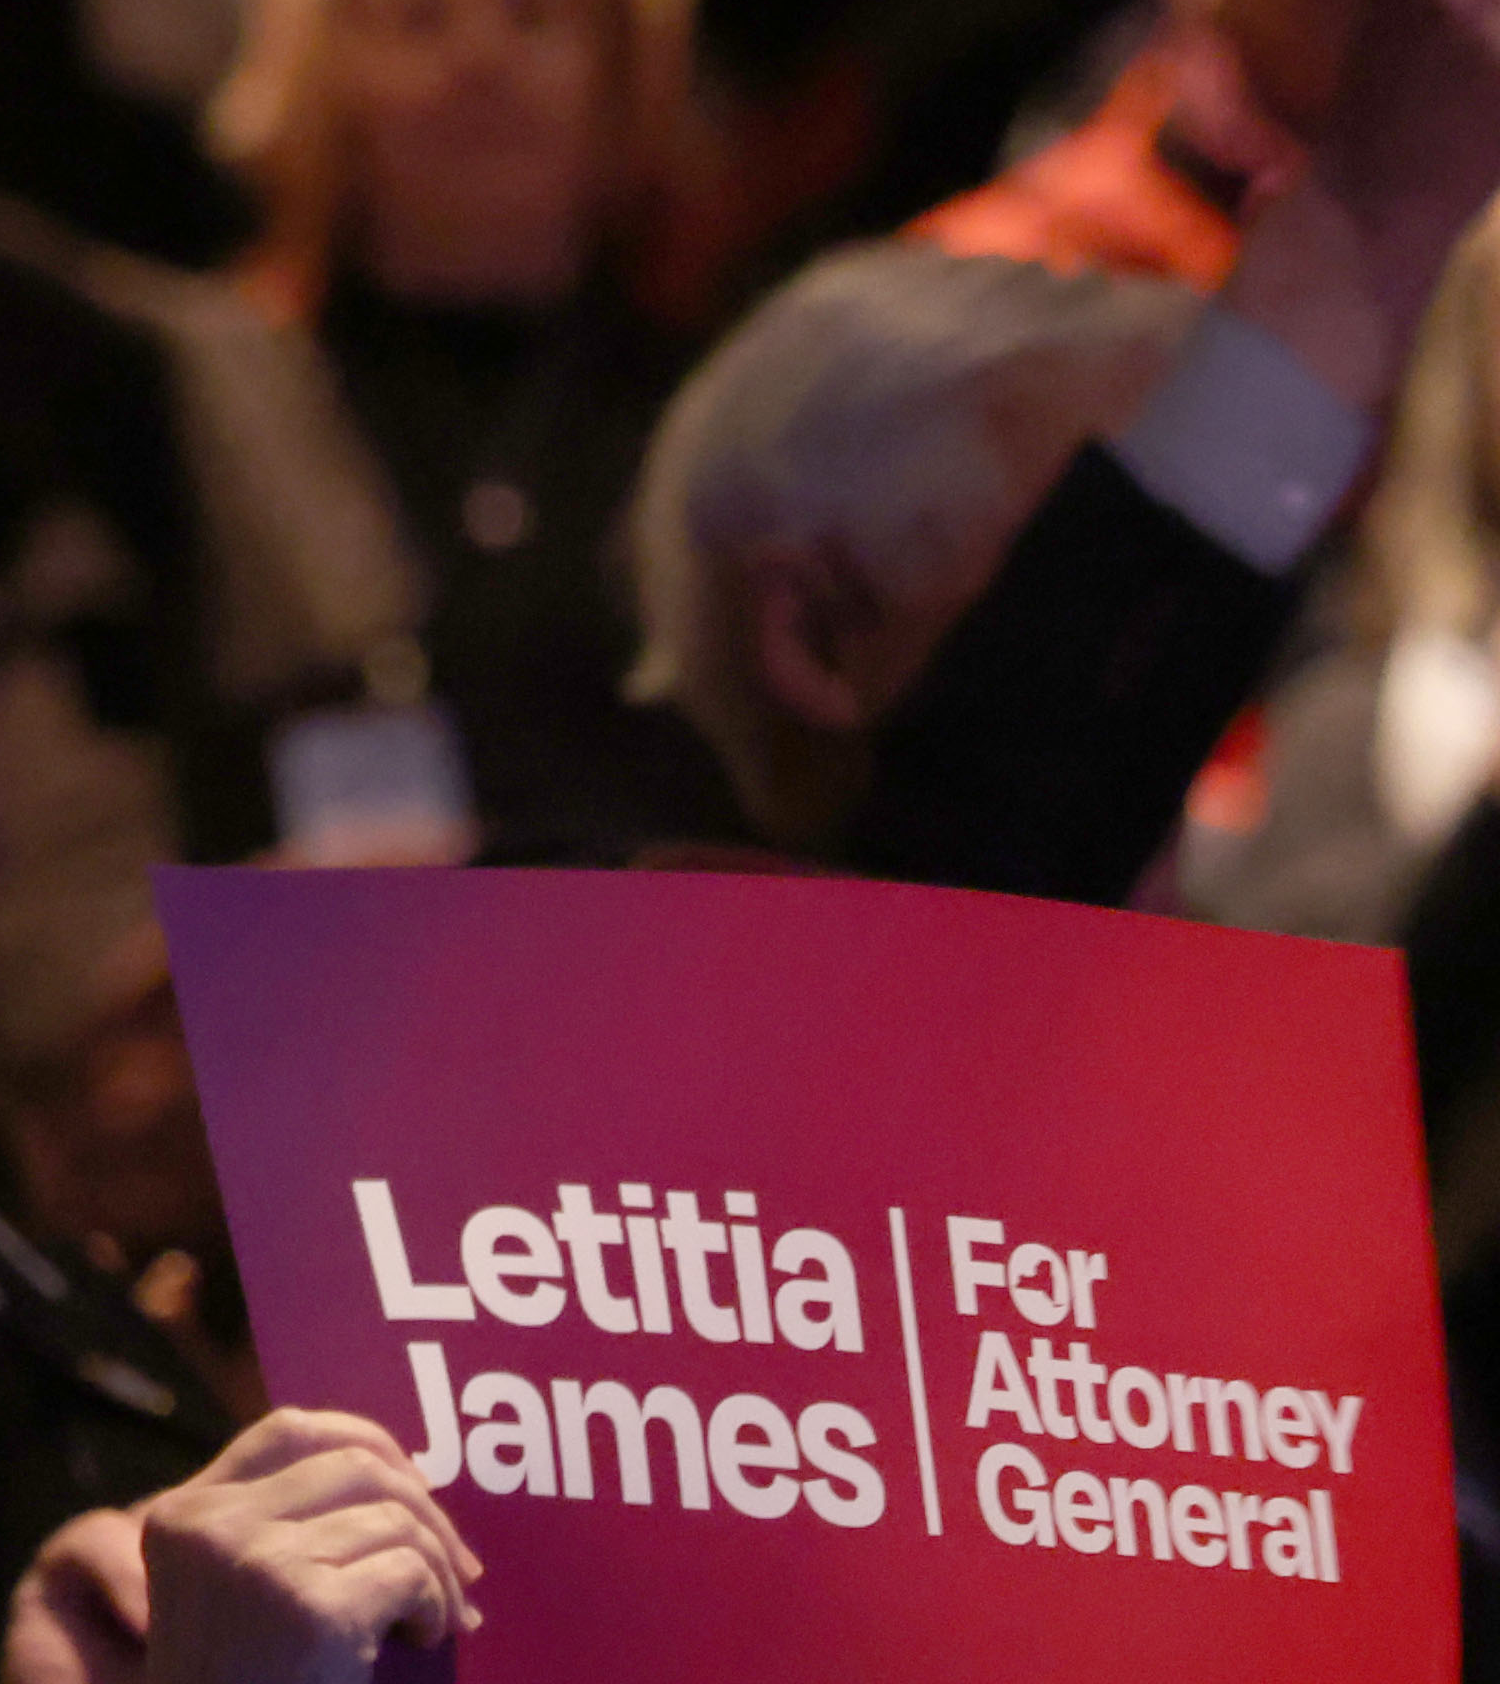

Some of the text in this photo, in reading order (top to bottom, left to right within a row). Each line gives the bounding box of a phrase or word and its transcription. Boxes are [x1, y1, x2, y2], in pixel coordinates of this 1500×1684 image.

[352, 1178, 865, 1354] Letitia
[946, 1215, 1108, 1329] For
[404, 1341, 886, 1529] James
[965, 1332, 1364, 1475] Attorney
[975, 1444, 1342, 1584] General
